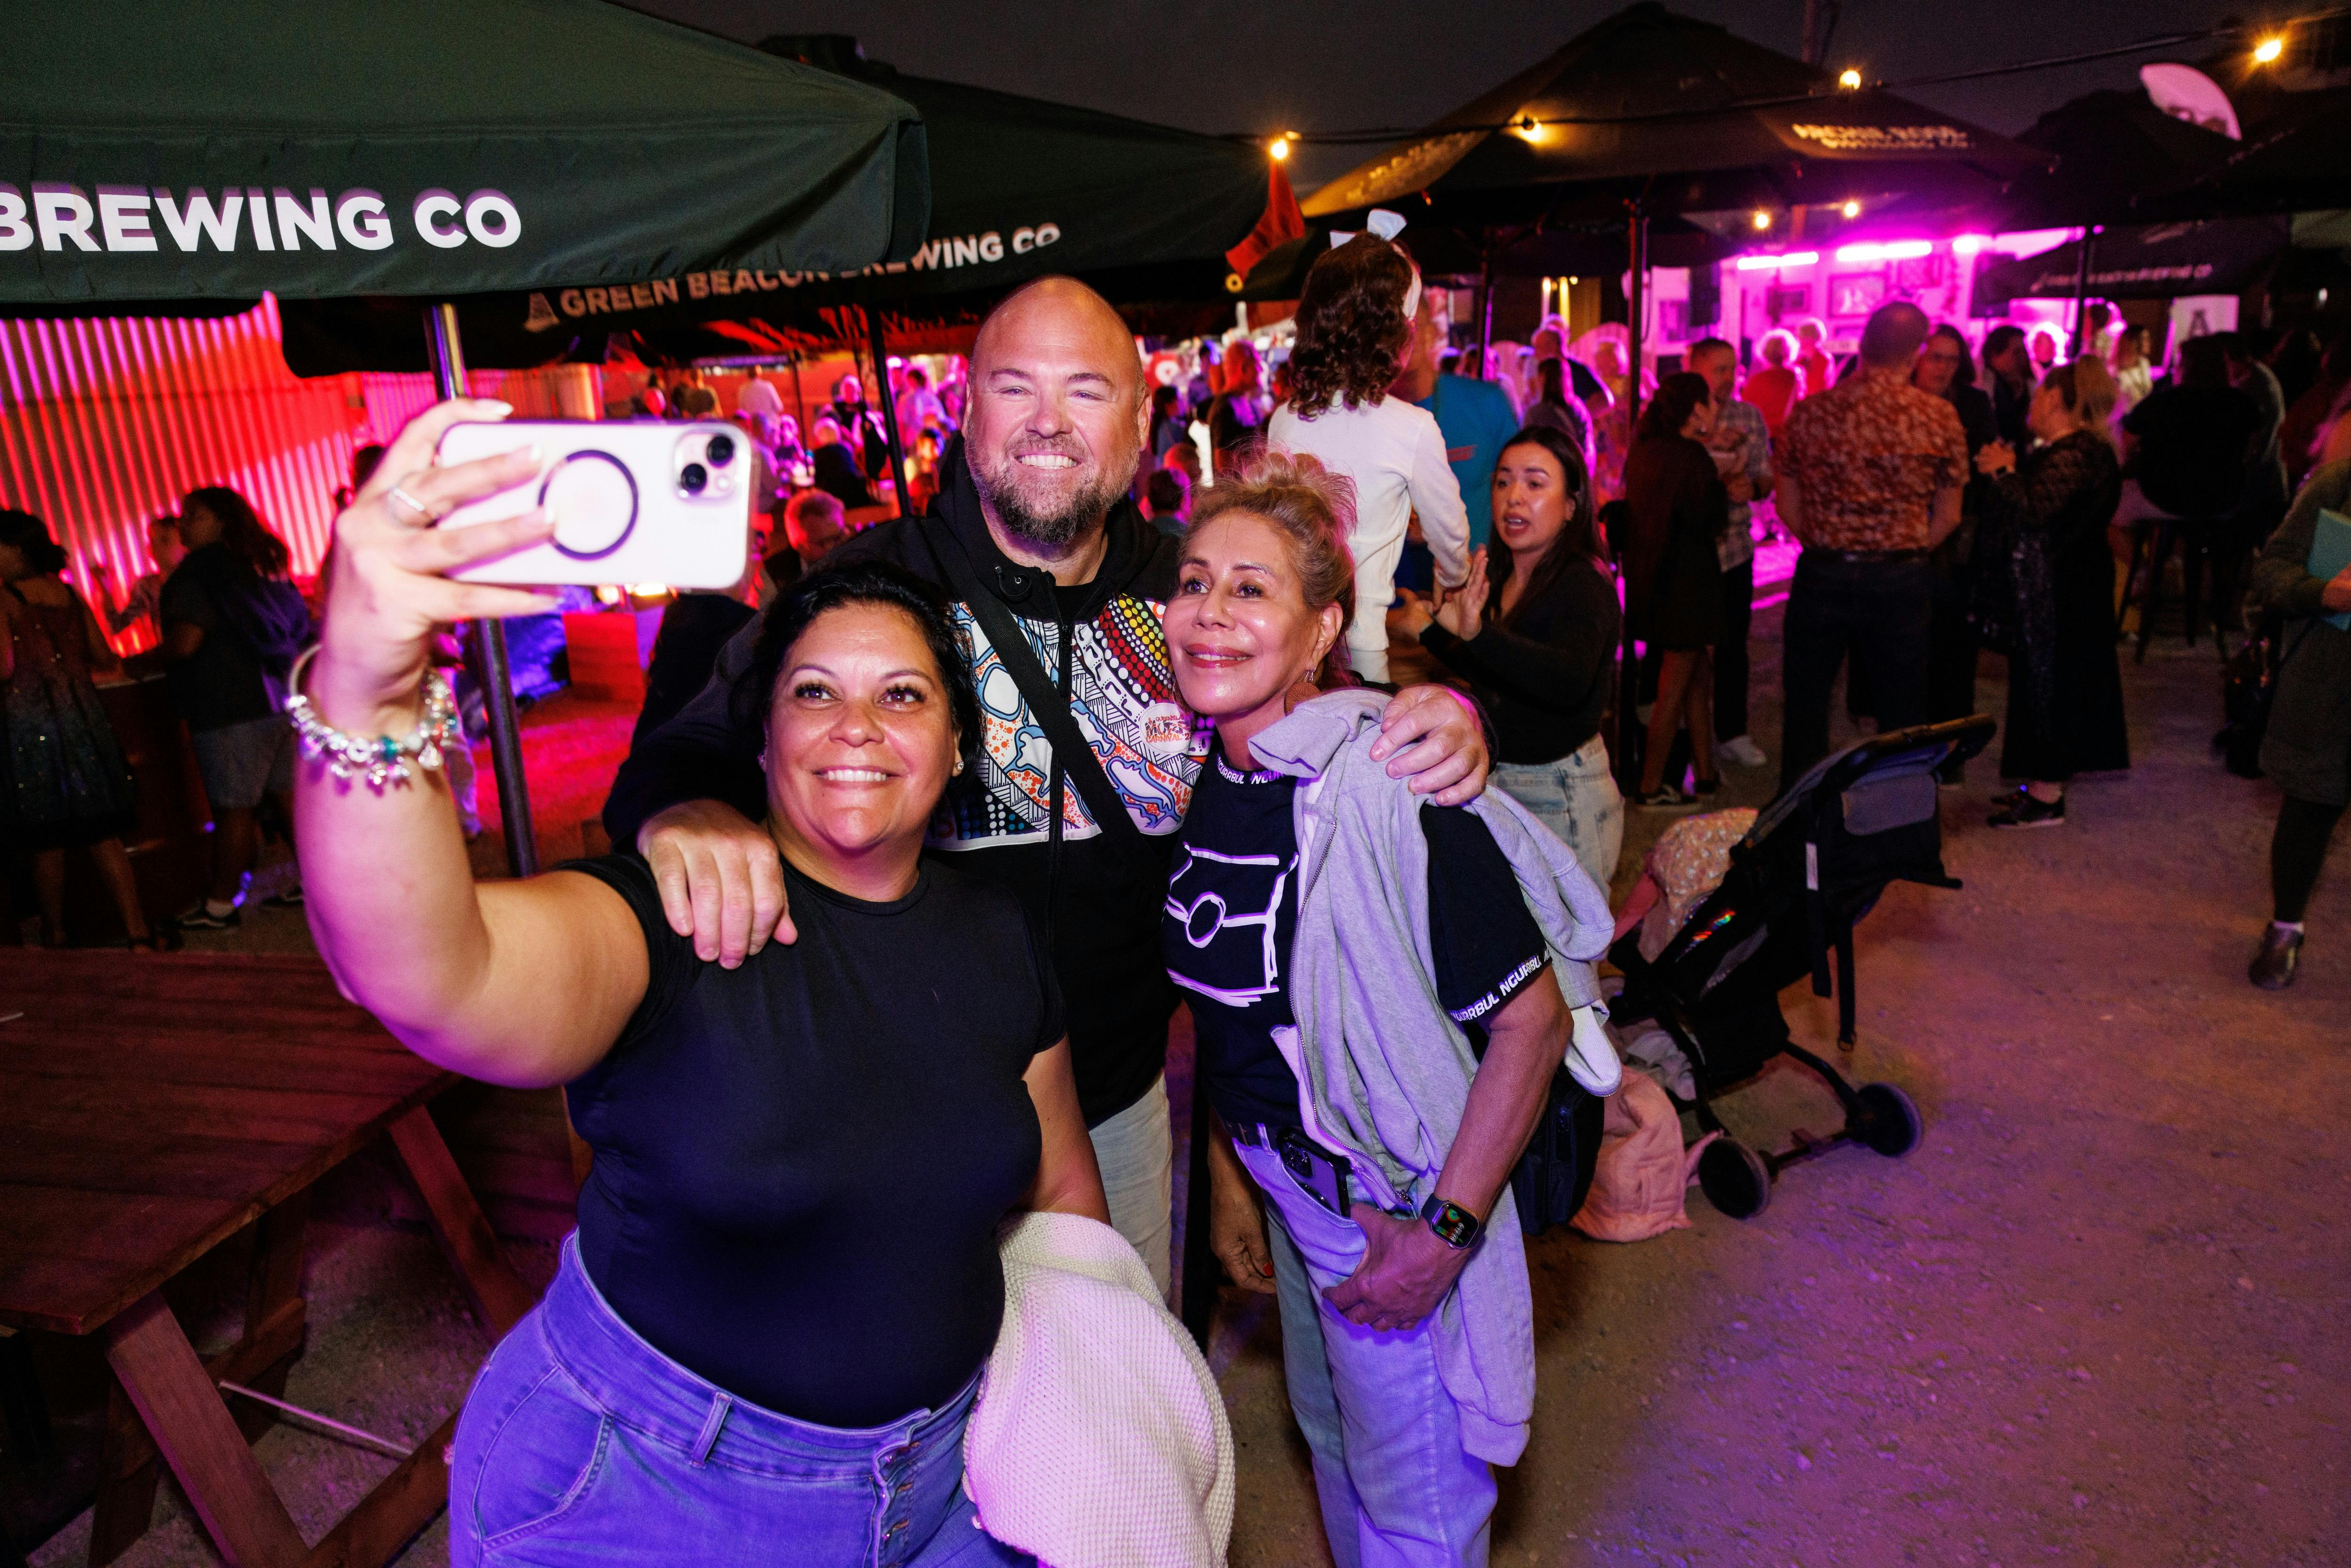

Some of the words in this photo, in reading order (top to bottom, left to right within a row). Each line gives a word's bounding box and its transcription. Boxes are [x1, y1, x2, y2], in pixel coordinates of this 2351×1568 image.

[0, 186, 394, 252] BREWING
[413, 189, 522, 249] CO
[560, 278, 679, 317] GREEN
[1012, 222, 1061, 254] CO
[1146, 733, 1182, 743] CARNIVAL
